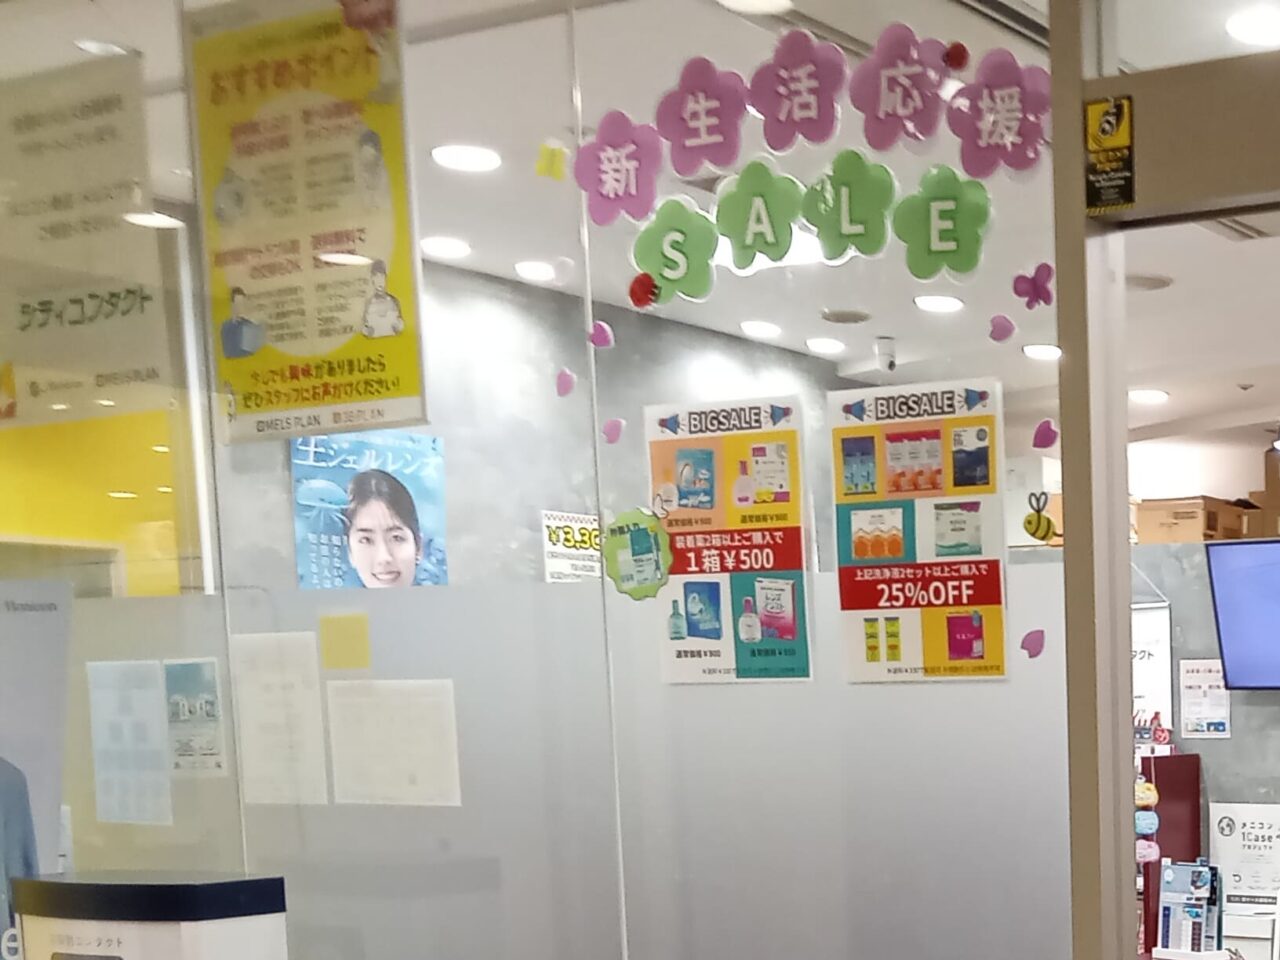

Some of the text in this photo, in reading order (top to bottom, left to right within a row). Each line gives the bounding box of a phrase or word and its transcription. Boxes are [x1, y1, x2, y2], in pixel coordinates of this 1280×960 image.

[599, 62, 1022, 199] 新生活応援
[662, 186, 957, 280] SALE
[17, 283, 153, 331] シティコンタクト
[876, 580, 974, 607] 25%OFF
